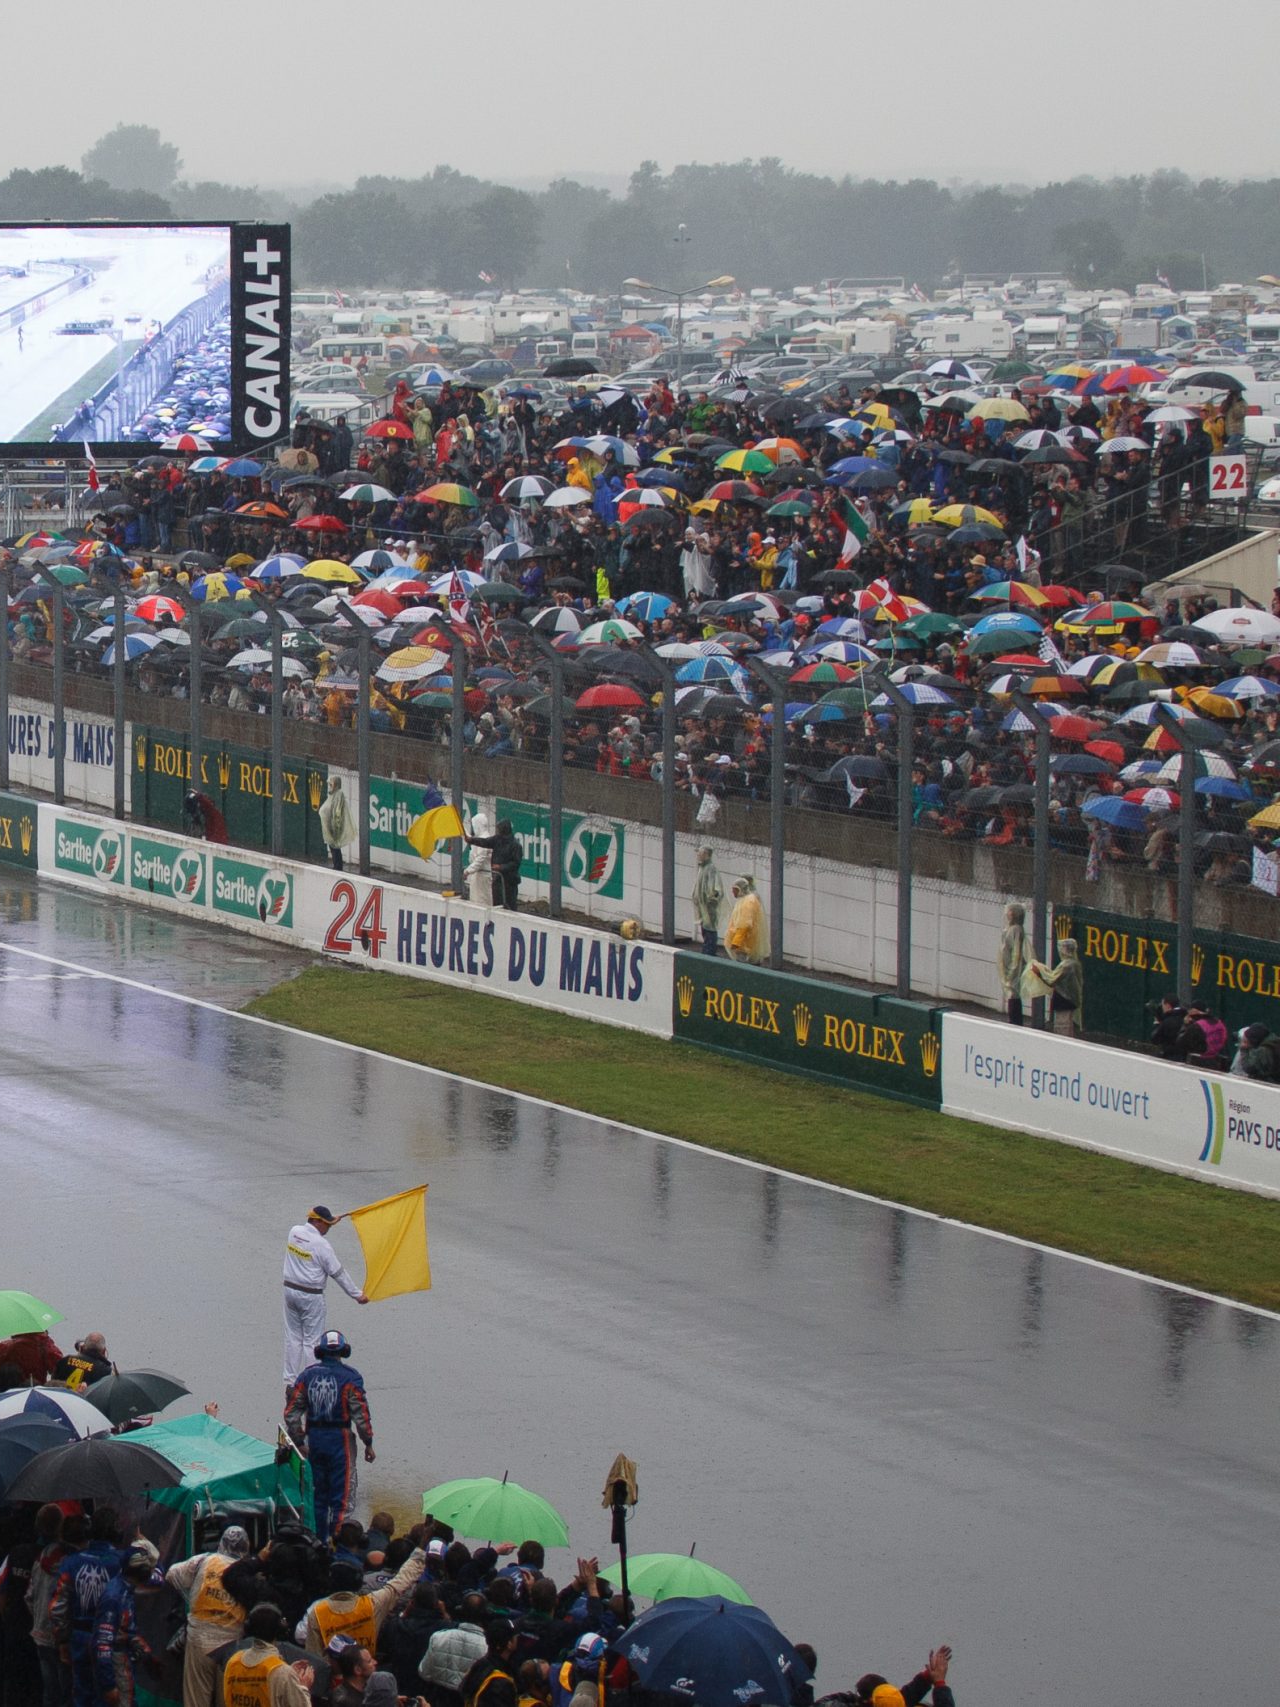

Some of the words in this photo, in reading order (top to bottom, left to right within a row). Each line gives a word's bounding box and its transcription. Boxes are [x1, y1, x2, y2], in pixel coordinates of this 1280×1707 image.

[243, 238, 282, 438] CANAL+
[1212, 463, 1245, 491] 22
[73, 721, 114, 767] MANS
[239, 762, 300, 805] ROLX
[58, 831, 92, 865] Sarthe
[134, 850, 171, 885] Sarthe
[215, 871, 255, 907] Sarthe
[322, 878, 387, 959] 24
[397, 909, 495, 978] HEURES
[507, 926, 548, 987] DU
[559, 935, 645, 1002] MANS
[1084, 925, 1169, 974] ROLEX
[704, 986, 781, 1034] ROLEX
[823, 1014, 906, 1065] ROLEX
[965, 1044, 1024, 1088] l'esprit
[1030, 1067, 1081, 1102] grand
[1087, 1082, 1150, 1120] ouvert
[1229, 1099, 1251, 1114] Région
[1228, 1116, 1262, 1146] PAYS
